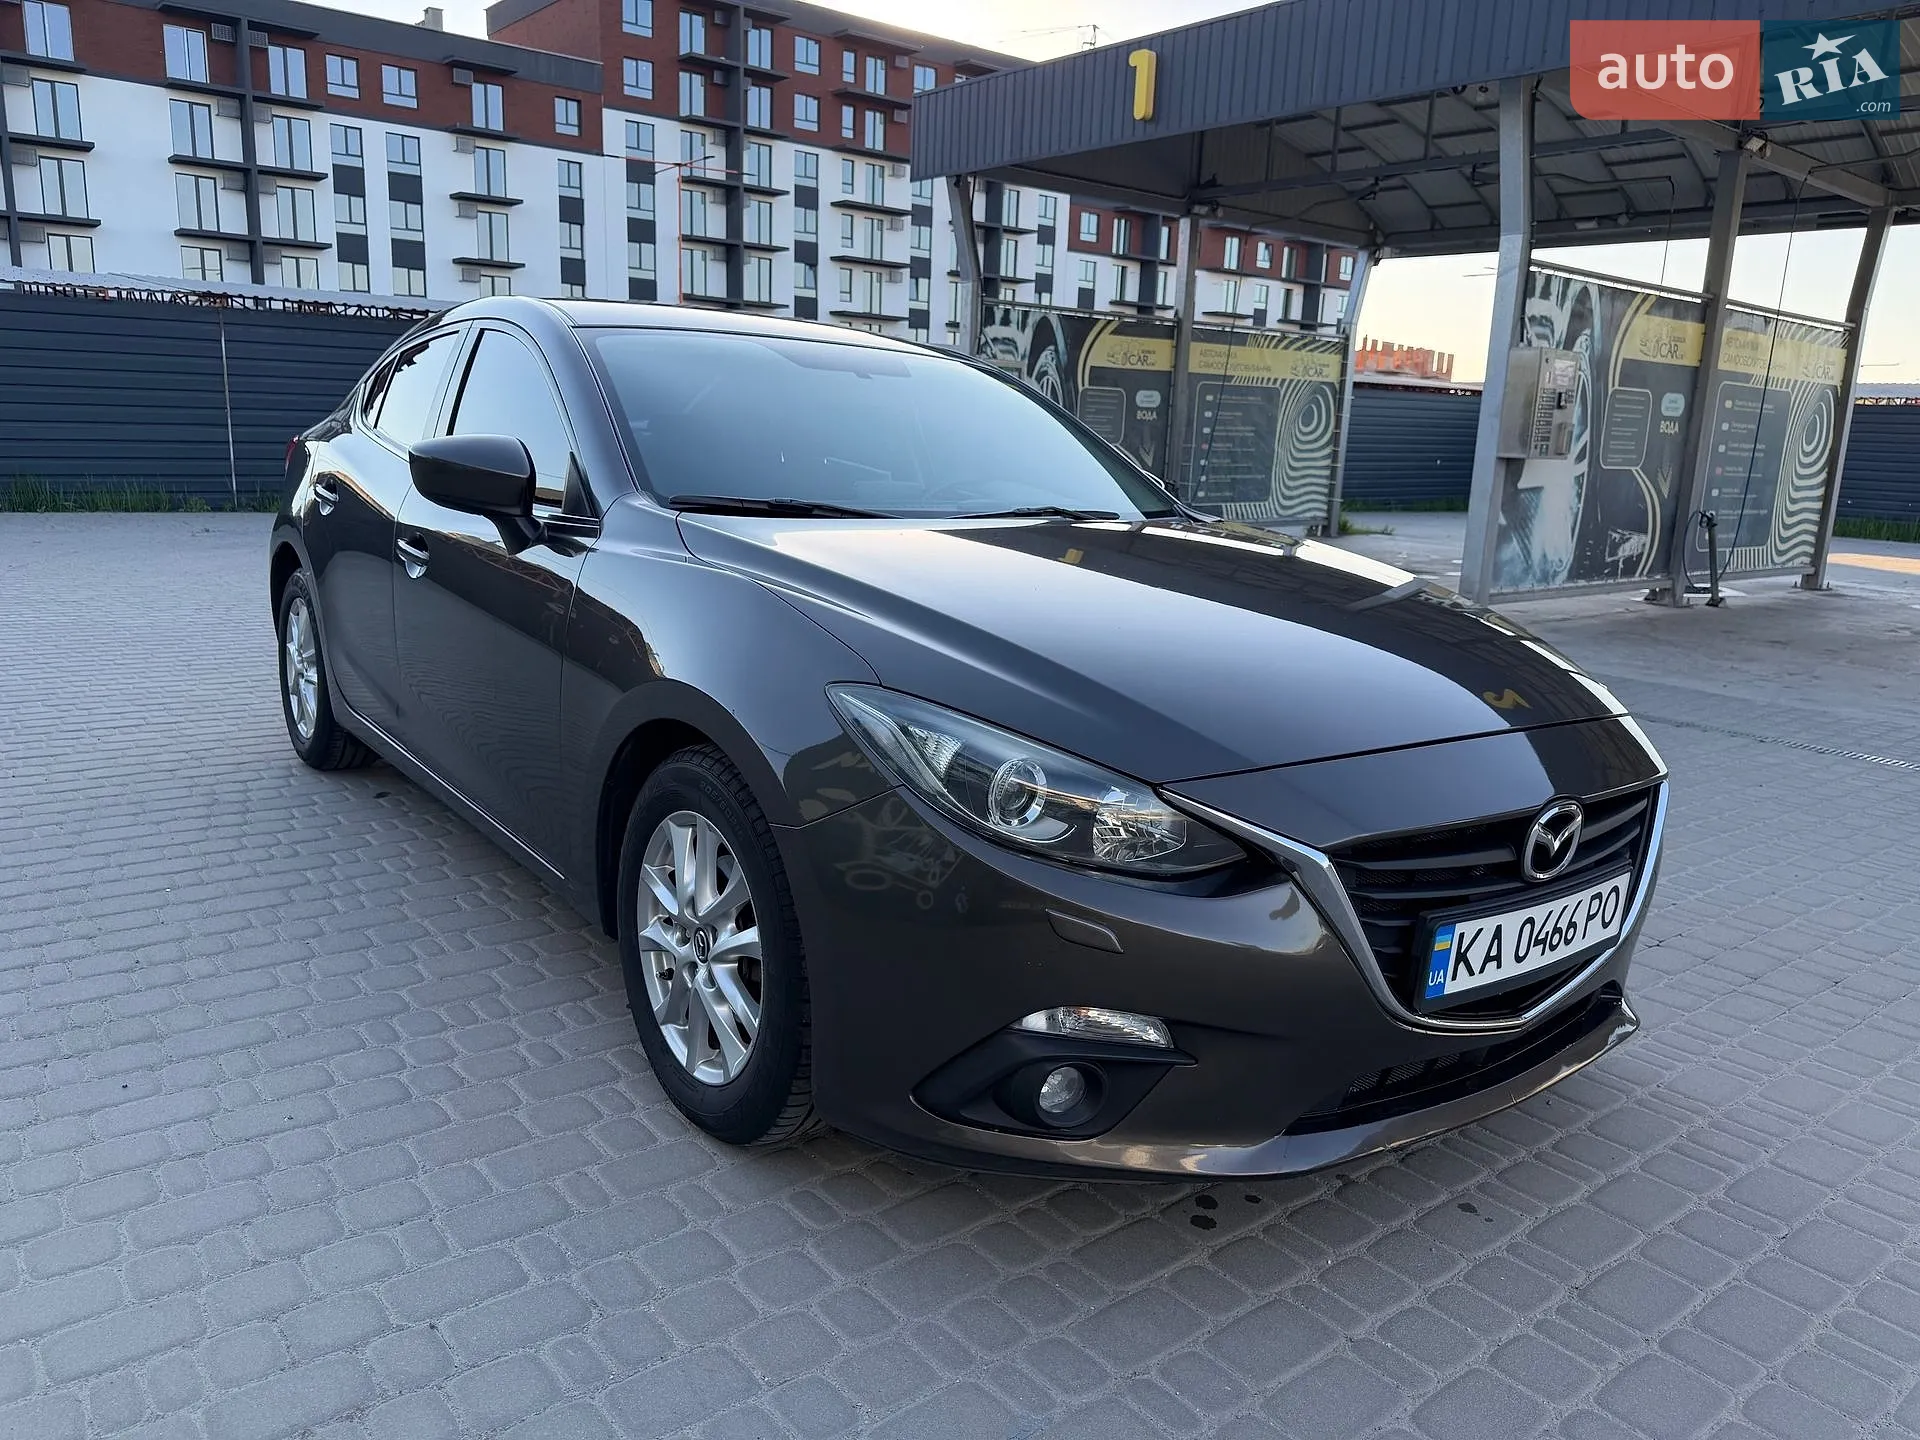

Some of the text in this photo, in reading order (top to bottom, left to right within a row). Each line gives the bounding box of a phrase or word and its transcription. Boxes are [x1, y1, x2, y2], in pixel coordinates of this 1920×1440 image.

[1128, 48, 1157, 120] 1
[1451, 884, 1621, 982] KA 0466 PO
[1428, 970, 1444, 986] UA
